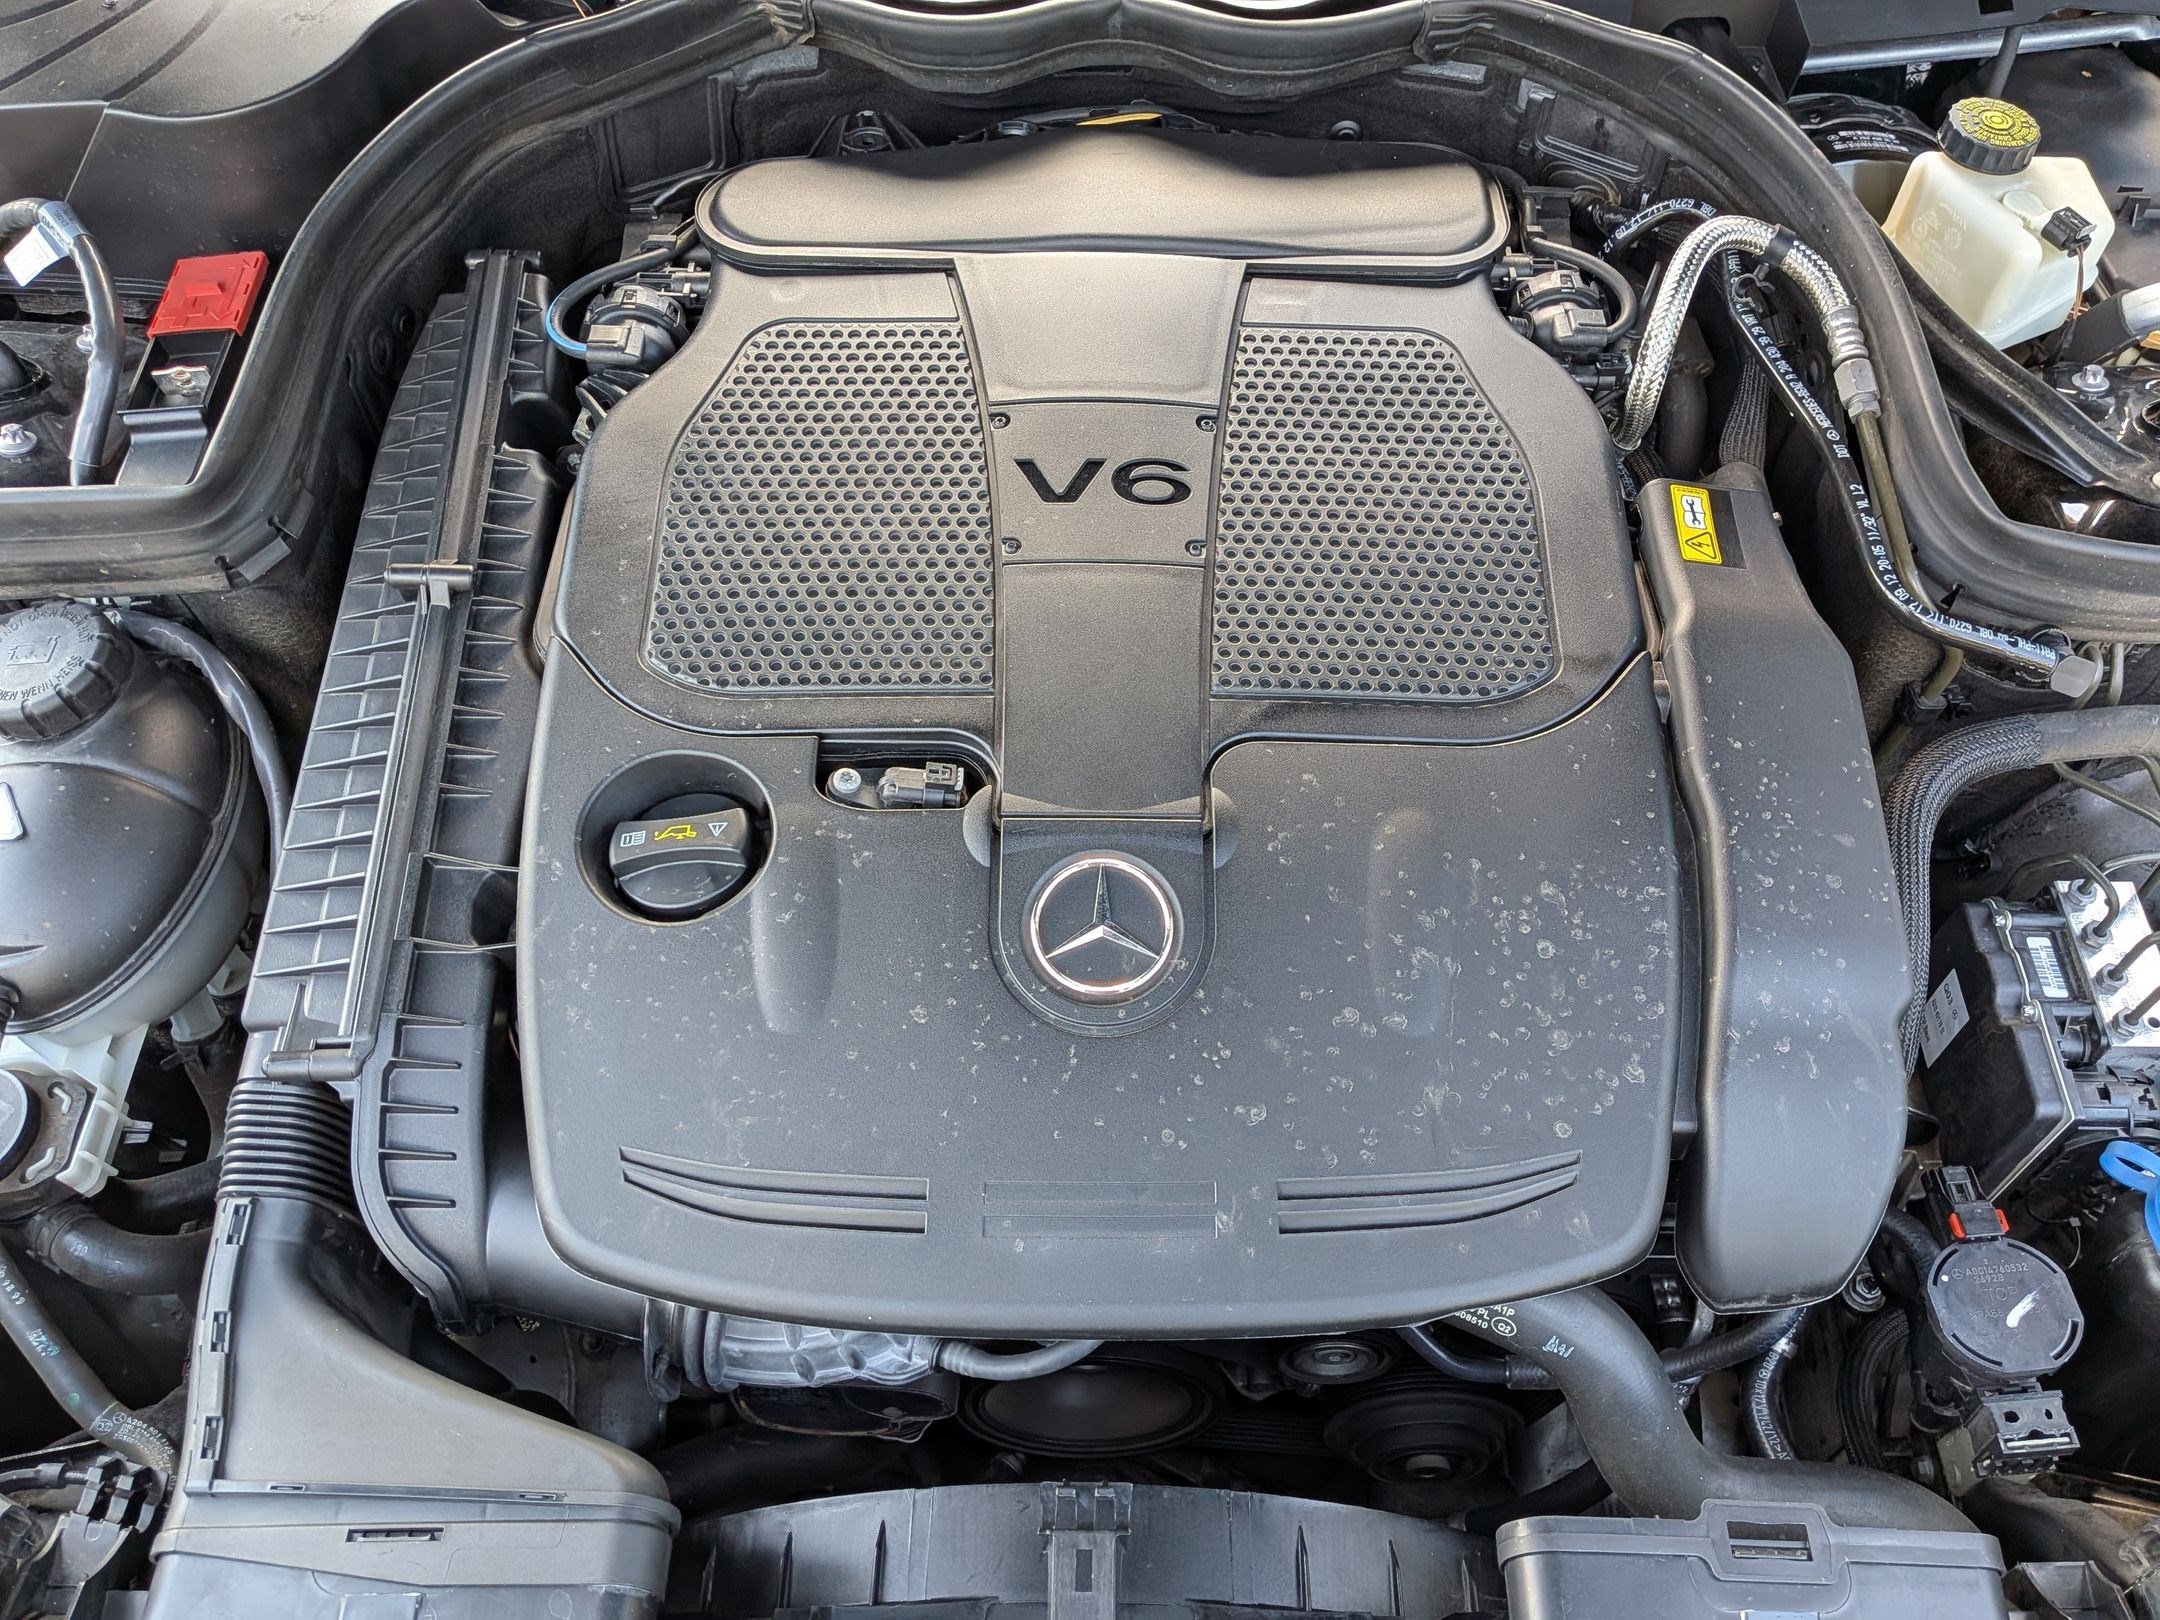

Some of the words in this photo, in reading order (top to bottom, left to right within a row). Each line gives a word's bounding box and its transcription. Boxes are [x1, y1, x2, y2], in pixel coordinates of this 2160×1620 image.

[1700, 201, 1717, 216] DBL
[1751, 326, 1765, 336] 29
[1759, 335, 1773, 346] 39
[1765, 346, 1782, 359] 430
[1776, 360, 1793, 373] 204
[1789, 381, 1834, 429] MERCEDES-BENZ
[1833, 444, 1850, 458] DOT
[1013, 457, 1193, 506] V6
[1849, 483, 1865, 495] L2
[1860, 513, 1882, 541] 11/32"
[1871, 544, 1892, 571] 20:05
[1883, 573, 1924, 613] 17.09.12
[3, 621, 24, 637] NOT
[1976, 625, 1994, 640] DBL
[21, 678, 53, 698] WENN
[1943, 982, 1954, 1006] Q03
[1965, 1263, 2030, 1277] A0014760532
[1974, 1274, 2005, 1284] 2692B
[1497, 1322, 1512, 1334] Q2
[1762, 1351, 1779, 1370] B20
[126, 1416, 148, 1429] A204
